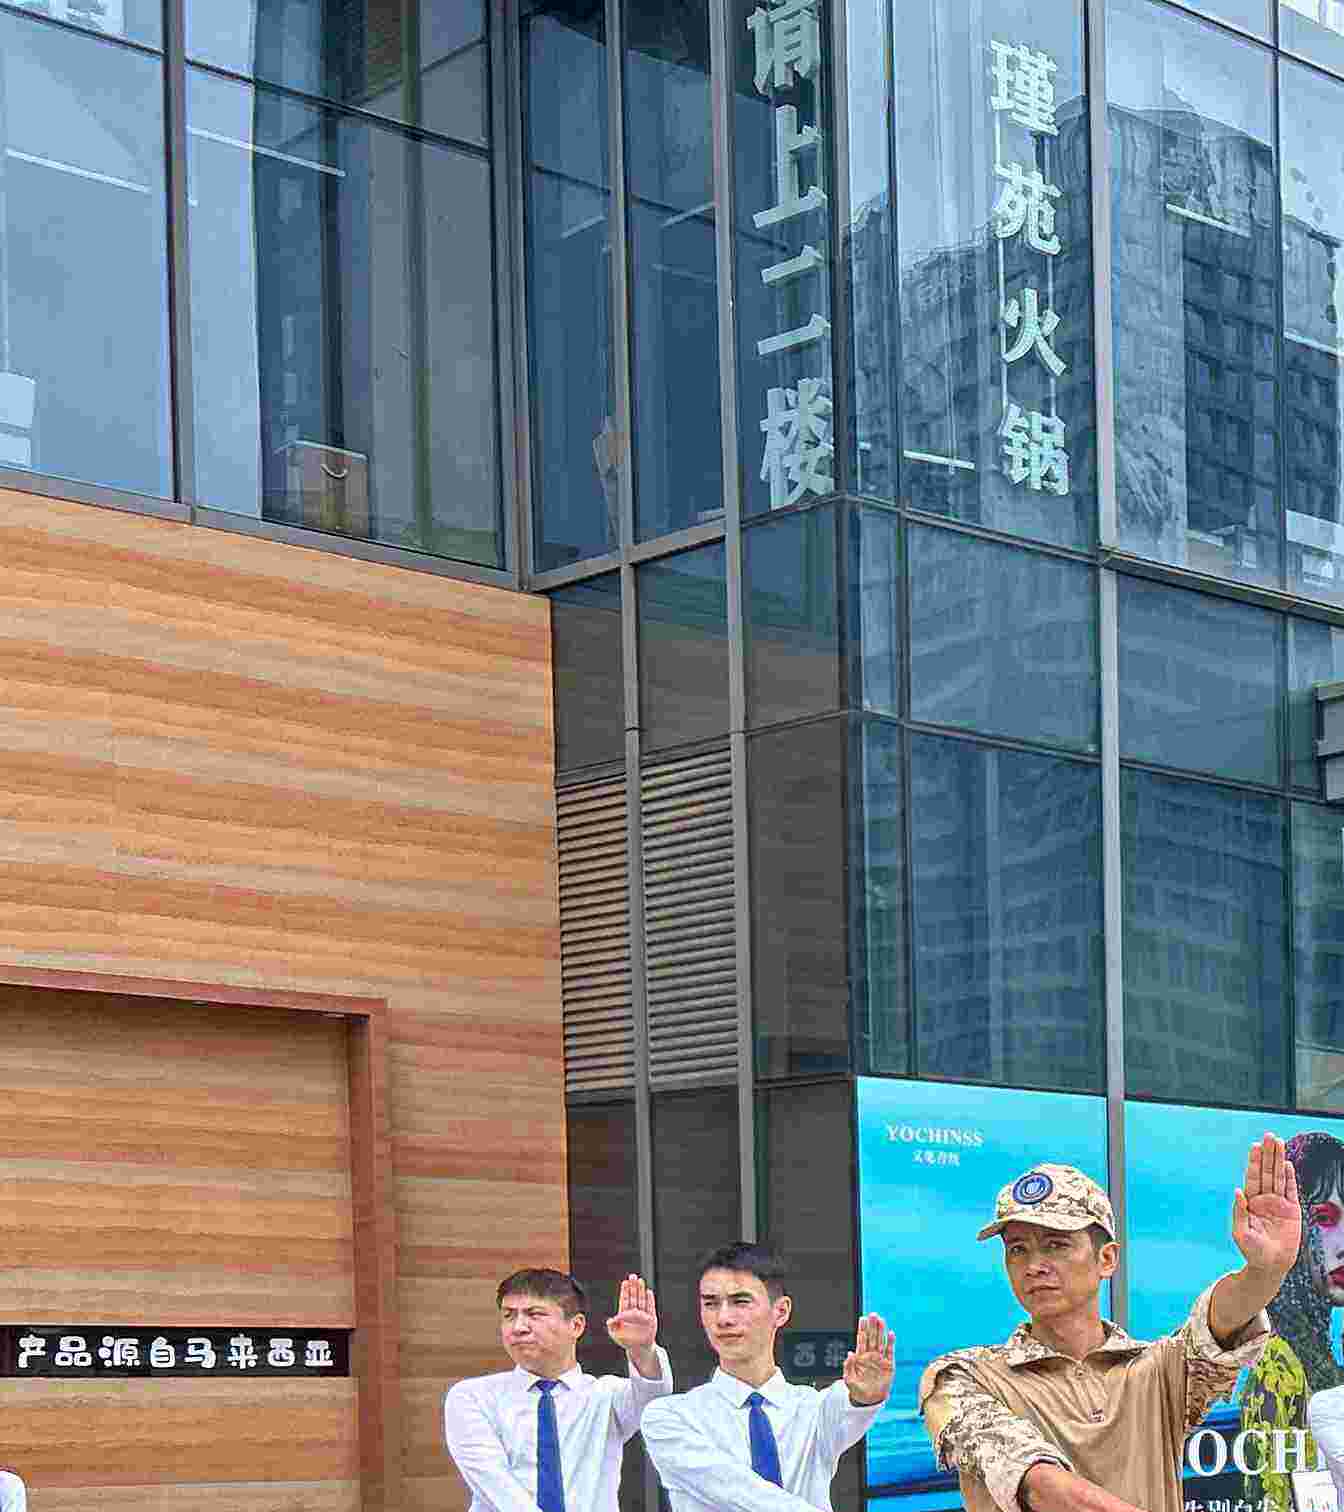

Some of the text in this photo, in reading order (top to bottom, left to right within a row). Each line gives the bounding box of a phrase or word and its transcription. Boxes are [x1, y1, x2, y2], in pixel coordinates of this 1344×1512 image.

[745, 0, 834, 509] 请上二楼
[884, 1123, 985, 1148] YOCHINSS
[17, 1333, 335, 1370] 产品源自马来西亚
